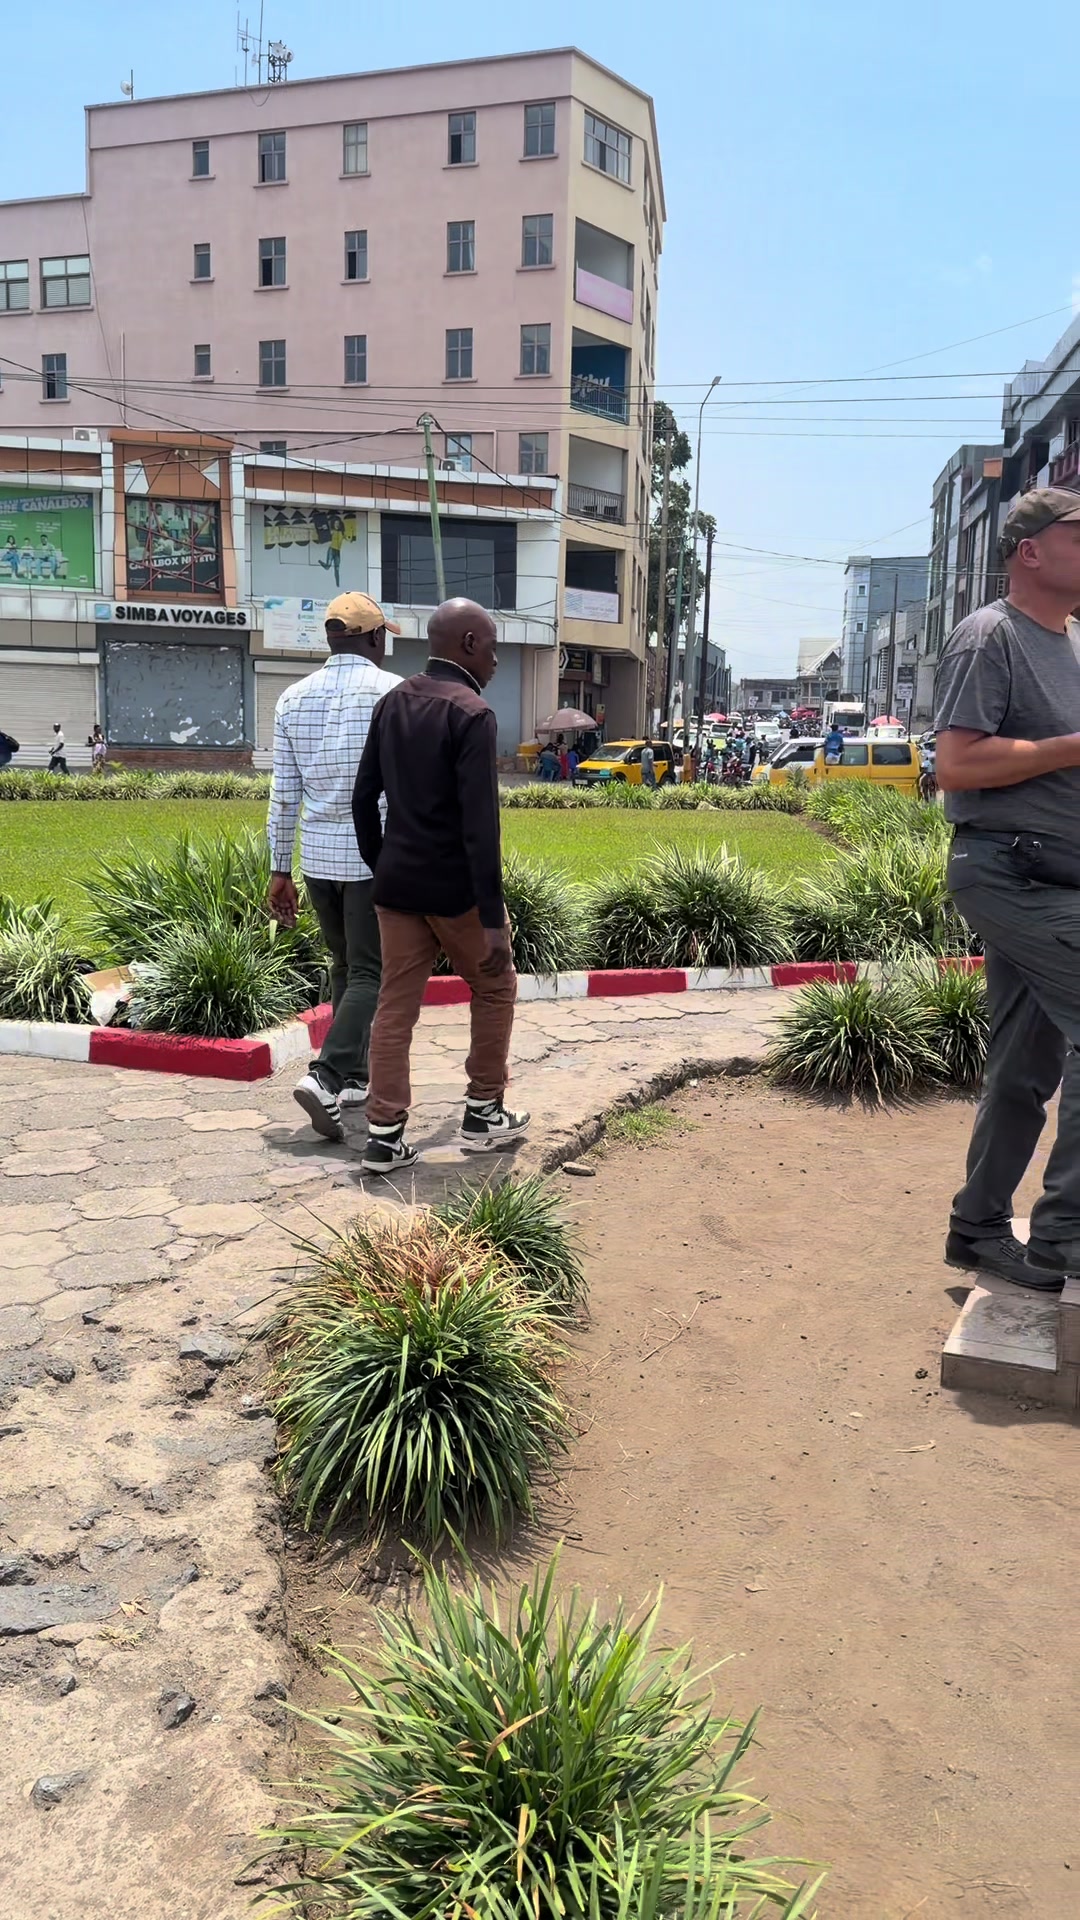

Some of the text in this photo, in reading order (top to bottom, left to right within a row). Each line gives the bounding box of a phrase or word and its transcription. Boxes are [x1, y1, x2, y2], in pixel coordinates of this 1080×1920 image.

[22, 497, 89, 512] CANALBOX
[129, 557, 178, 570] CLBOX
[115, 606, 247, 625] SIMBA VOYAGES
